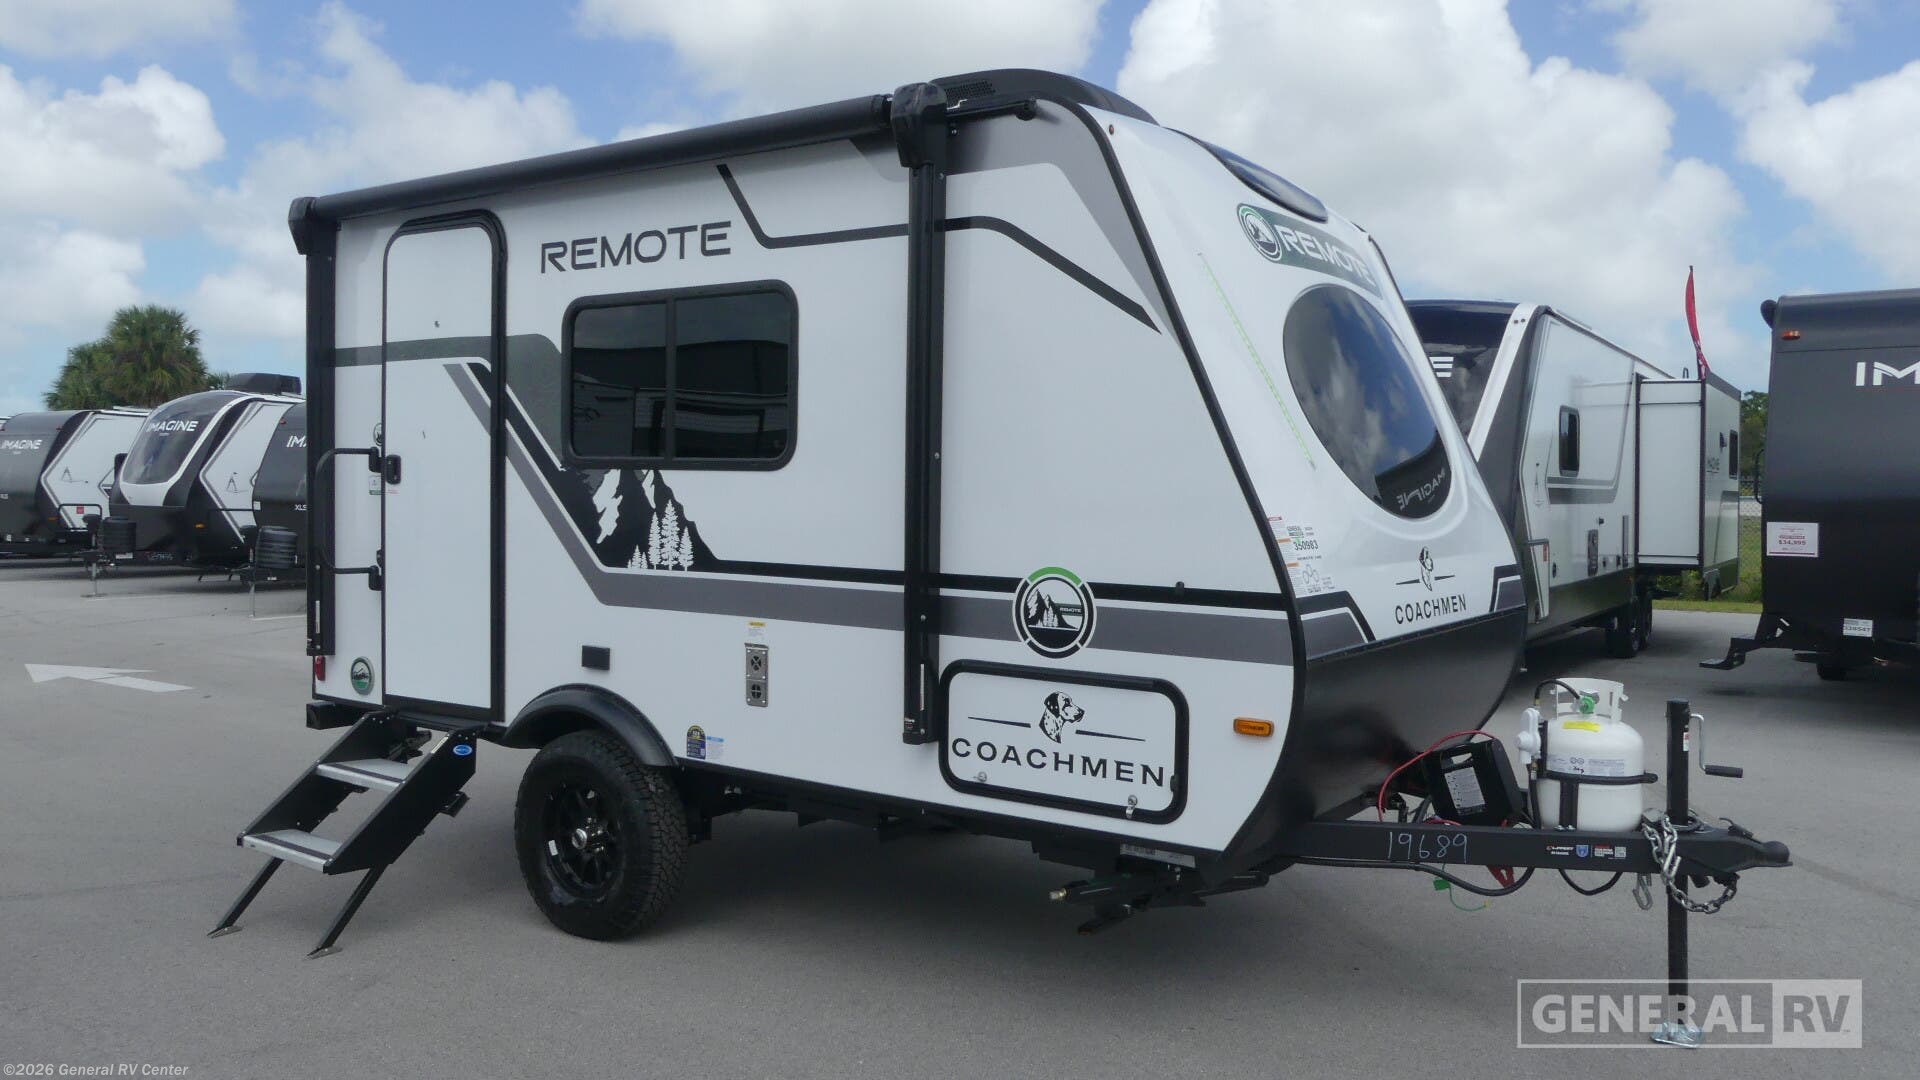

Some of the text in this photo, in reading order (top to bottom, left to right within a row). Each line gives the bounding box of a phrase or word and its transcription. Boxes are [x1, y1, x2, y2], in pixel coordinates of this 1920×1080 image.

[540, 220, 731, 274] REMOTE
[1274, 224, 1377, 288] REMOTE
[1, 439, 43, 449] IMAGINE
[1293, 539, 1319, 551] 350983
[1395, 593, 1467, 625] COACHMEN
[951, 737, 1164, 788] COACHMEN
[1387, 831, 1467, 864] 19689
